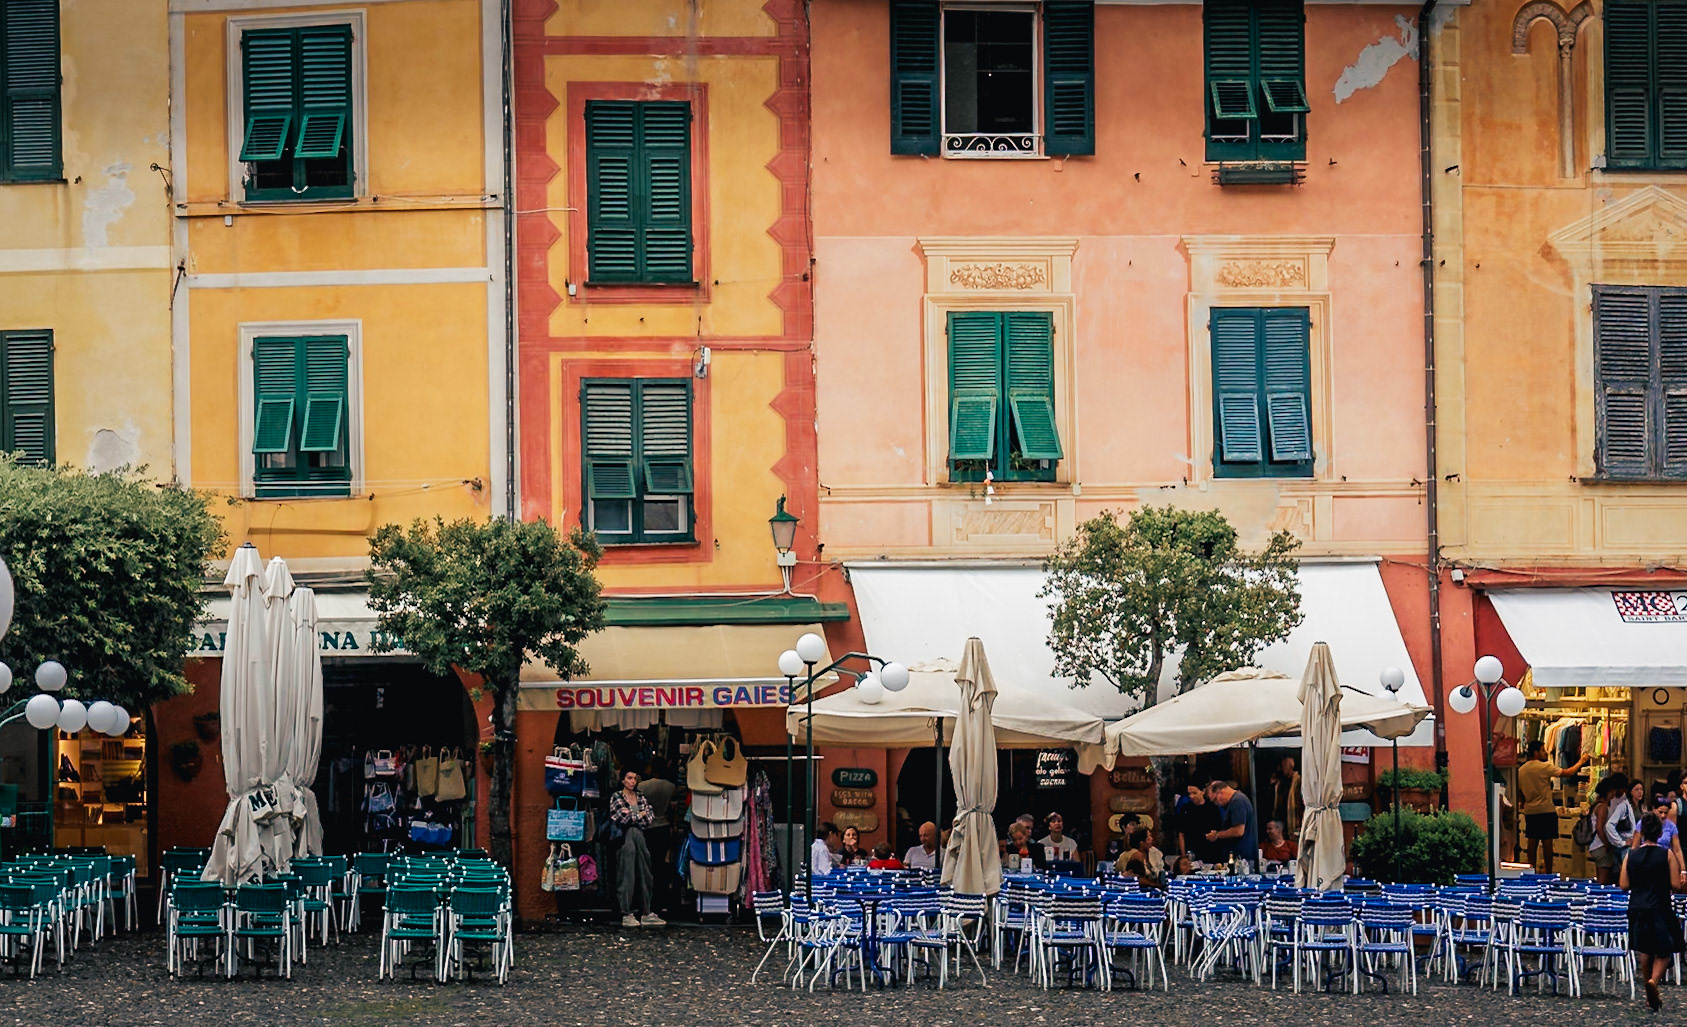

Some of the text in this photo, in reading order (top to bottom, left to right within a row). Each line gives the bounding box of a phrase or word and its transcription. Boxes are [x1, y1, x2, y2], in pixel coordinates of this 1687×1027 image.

[556, 685, 797, 709] SOUVENIR GAIES
[840, 771, 871, 782] PIZZA
